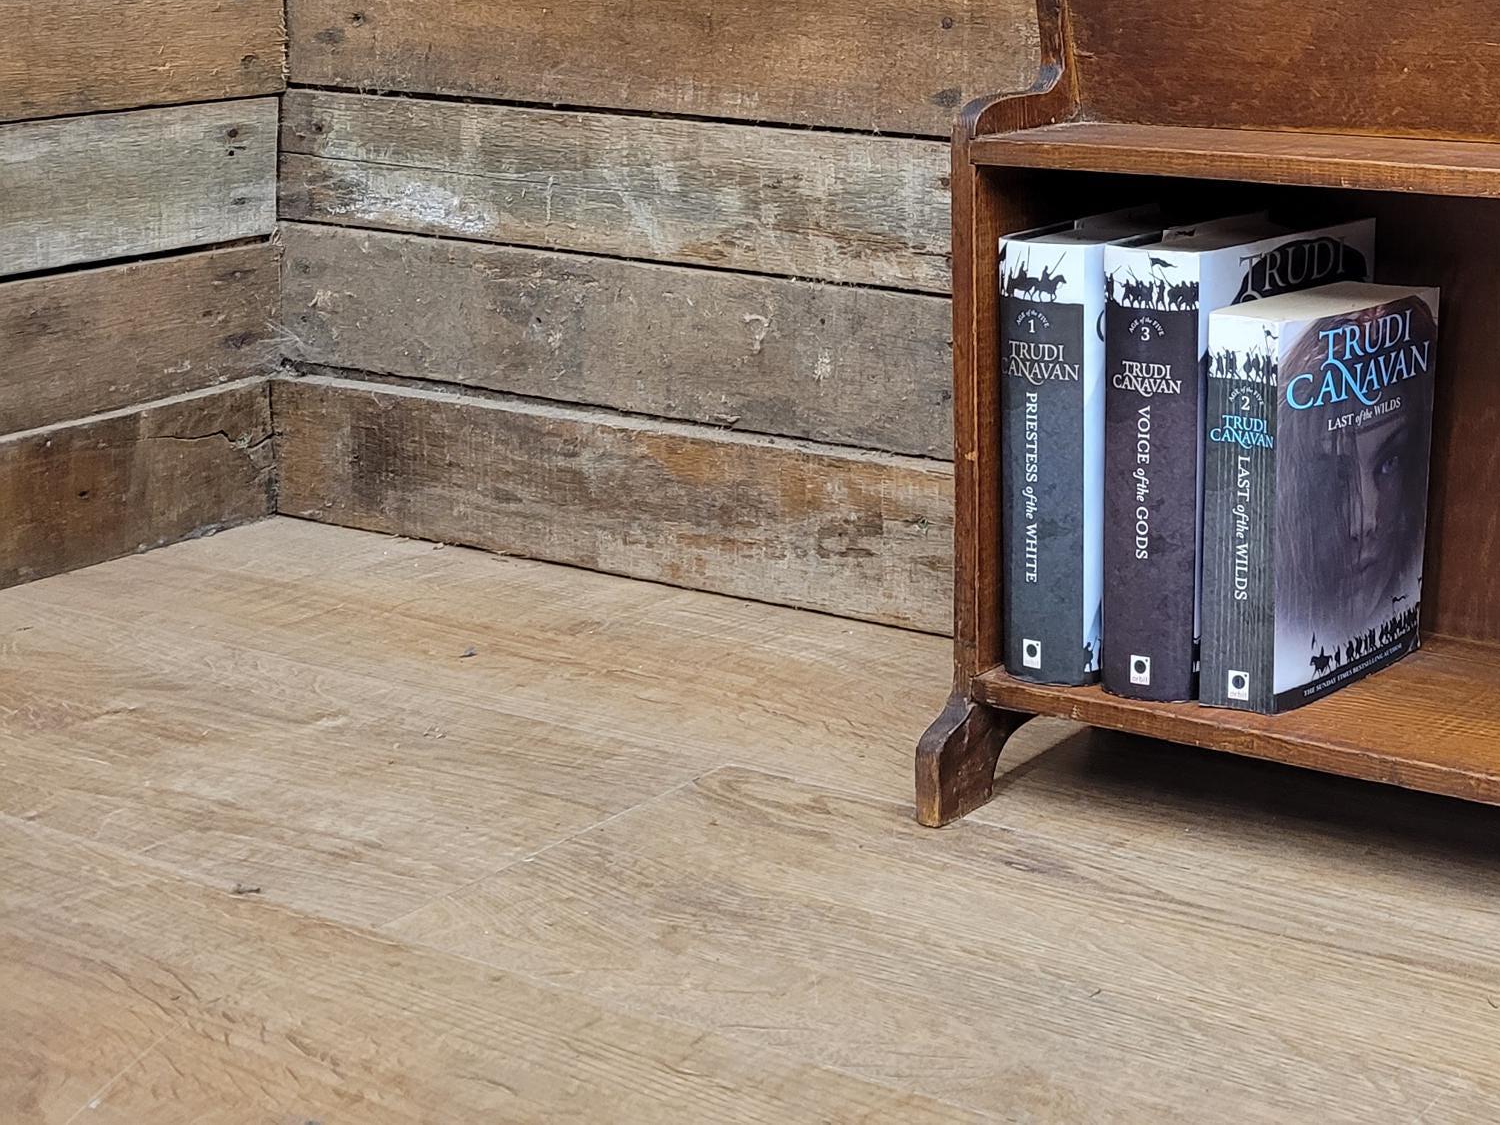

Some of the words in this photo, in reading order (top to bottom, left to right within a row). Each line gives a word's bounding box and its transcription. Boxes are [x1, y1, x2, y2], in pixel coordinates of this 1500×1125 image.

[1240, 237, 1345, 292] TRUDI
[1028, 319, 1036, 334] 1
[1140, 327, 1150, 341] 3
[1319, 309, 1413, 361] TRUDI
[1009, 340, 1064, 361] TRUDI
[1002, 355, 1080, 386] CANAVAN
[1113, 374, 1182, 397] CANAVAN
[1122, 360, 1171, 379] TRUDI
[1286, 342, 1430, 410] CANAVAN
[1241, 395, 1250, 411] 2
[1328, 414, 1354, 431] LAST
[1373, 396, 1401, 417] WILDS
[1025, 392, 1038, 483] PRIESTESS
[1137, 406, 1150, 464] VOICE
[1210, 427, 1273, 449] CANAVAN
[1222, 415, 1267, 433] TRUDI
[1237, 455, 1250, 502] LAST
[1135, 506, 1149, 560] GODS
[1025, 523, 1038, 583] WHITE
[1234, 542, 1249, 600] WILDS
[1303, 688, 1315, 696] THE
[1316, 678, 1336, 692] SUNDAY
[1337, 670, 1352, 681] TIMES
